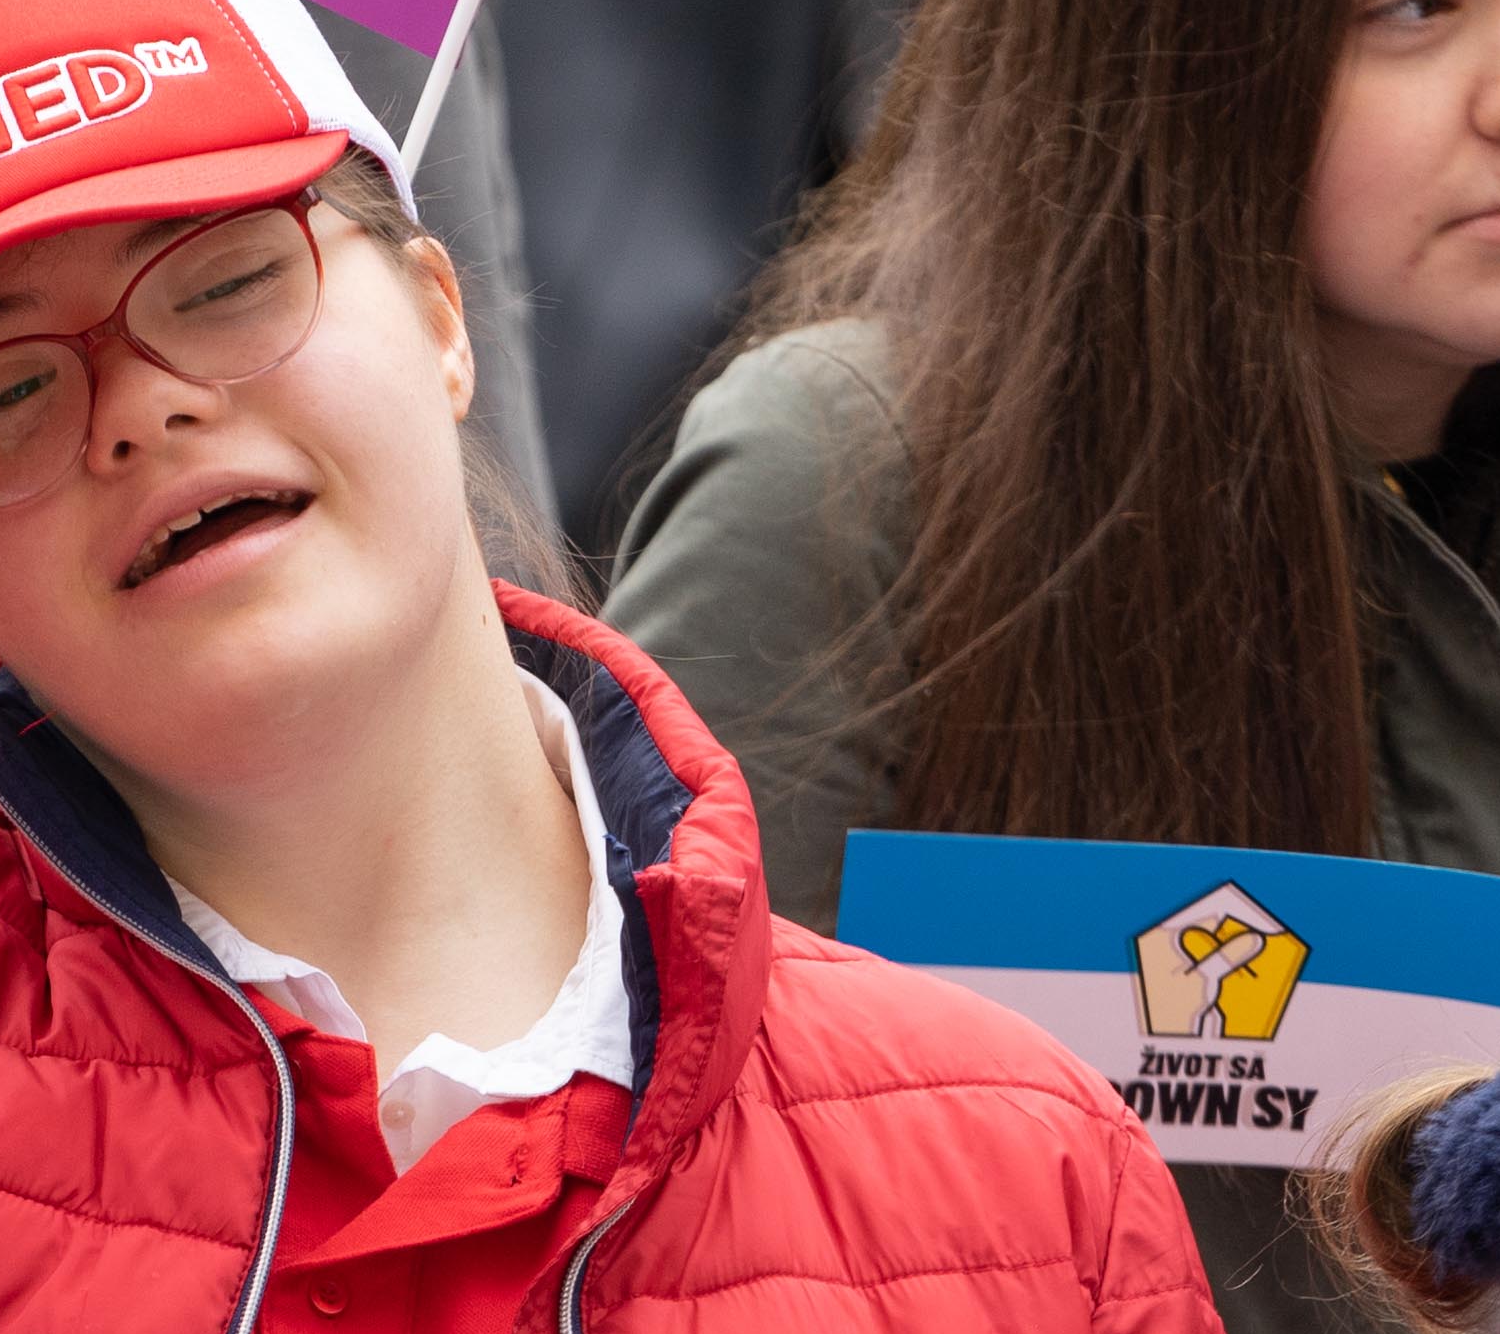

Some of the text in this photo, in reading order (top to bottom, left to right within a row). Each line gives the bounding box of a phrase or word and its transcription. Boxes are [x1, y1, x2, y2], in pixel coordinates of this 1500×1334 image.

[1138, 1045, 1266, 1081] ŽIVOT SA
[1108, 1078, 1318, 1132] OWN SY
